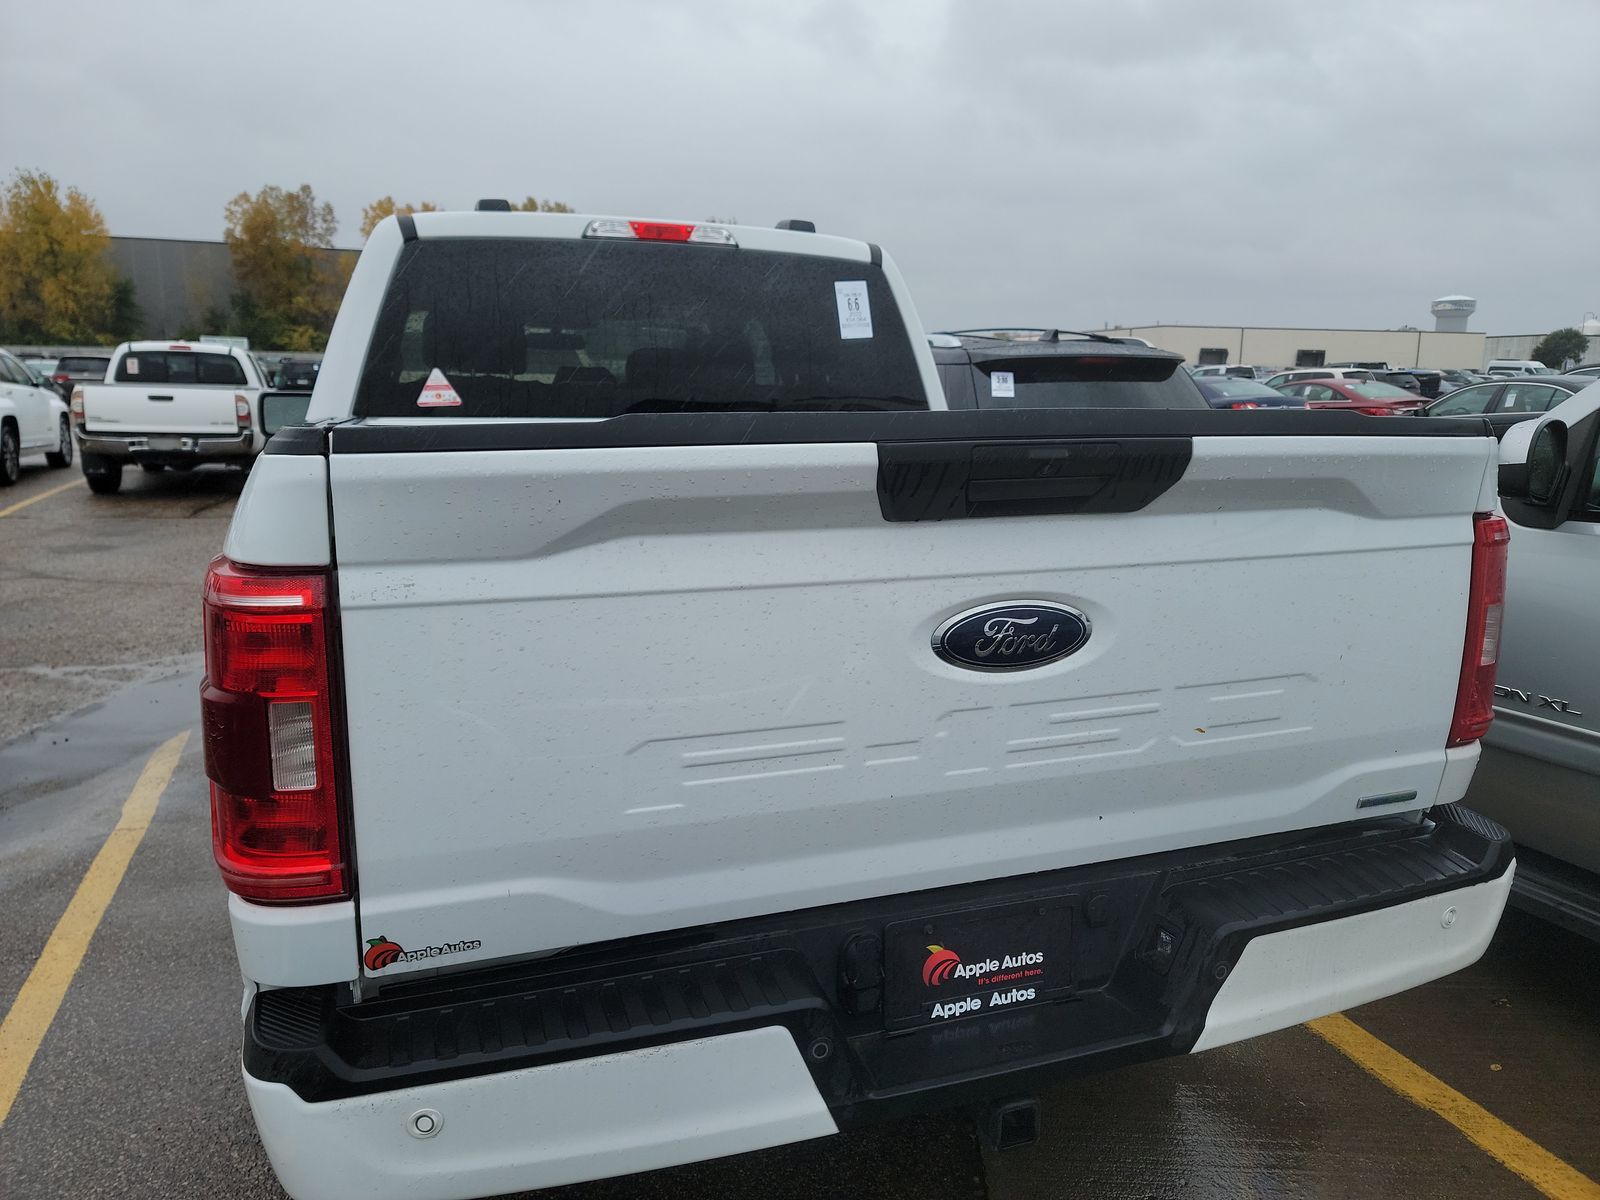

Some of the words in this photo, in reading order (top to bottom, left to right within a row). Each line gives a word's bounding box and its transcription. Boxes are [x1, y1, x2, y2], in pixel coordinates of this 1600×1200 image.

[974, 616, 1060, 658] Ford
[1537, 694, 1582, 715] XL
[397, 946, 441, 962] Apple
[441, 940, 481, 956] Autos
[953, 958, 1000, 979] Apple
[1001, 951, 1044, 970] Autos
[978, 977, 990, 986] It's
[991, 971, 1023, 984] different
[1024, 969, 1044, 978] here.
[930, 997, 982, 1019] Apple
[989, 988, 1036, 1007] Autos
